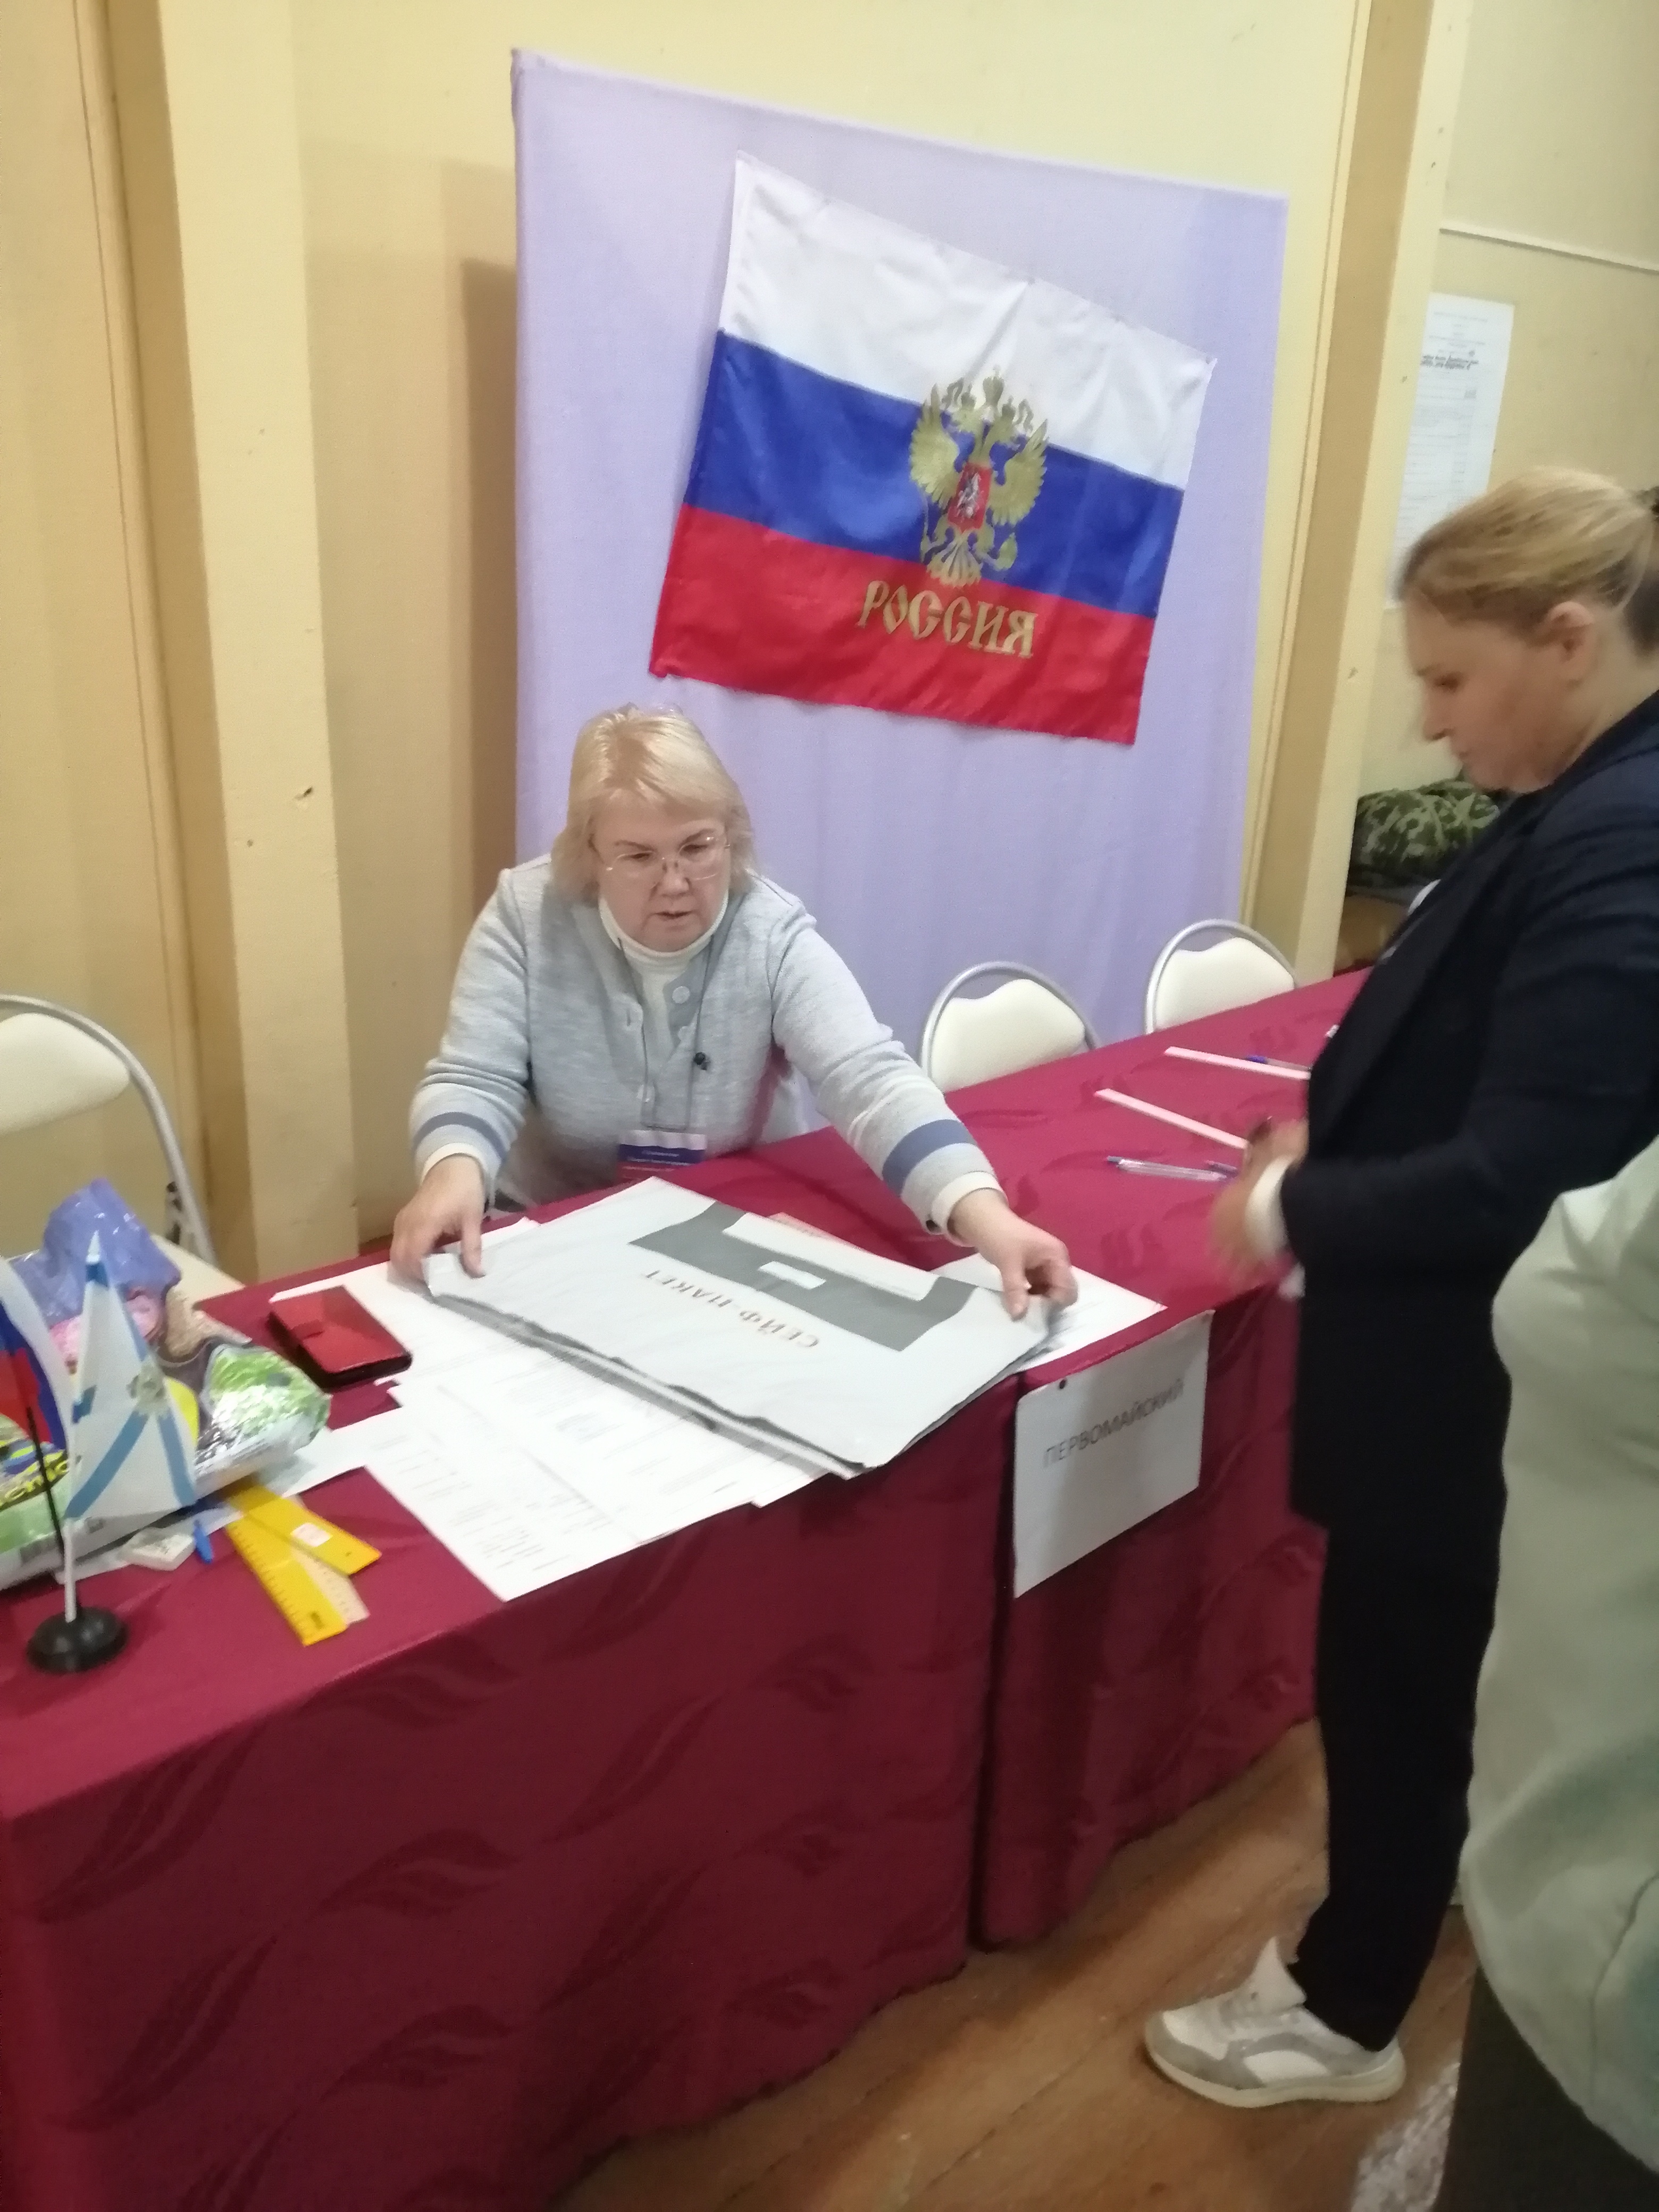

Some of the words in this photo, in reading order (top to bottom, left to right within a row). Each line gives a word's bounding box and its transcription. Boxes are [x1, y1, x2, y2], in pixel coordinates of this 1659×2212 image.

[856, 580, 1038, 658] РОССИЯ
[644, 1269, 819, 1348] СЕЙФ-ПАКЕТ
[1043, 1378, 1184, 1469] ПЕРВОМАЙСКИЙ
